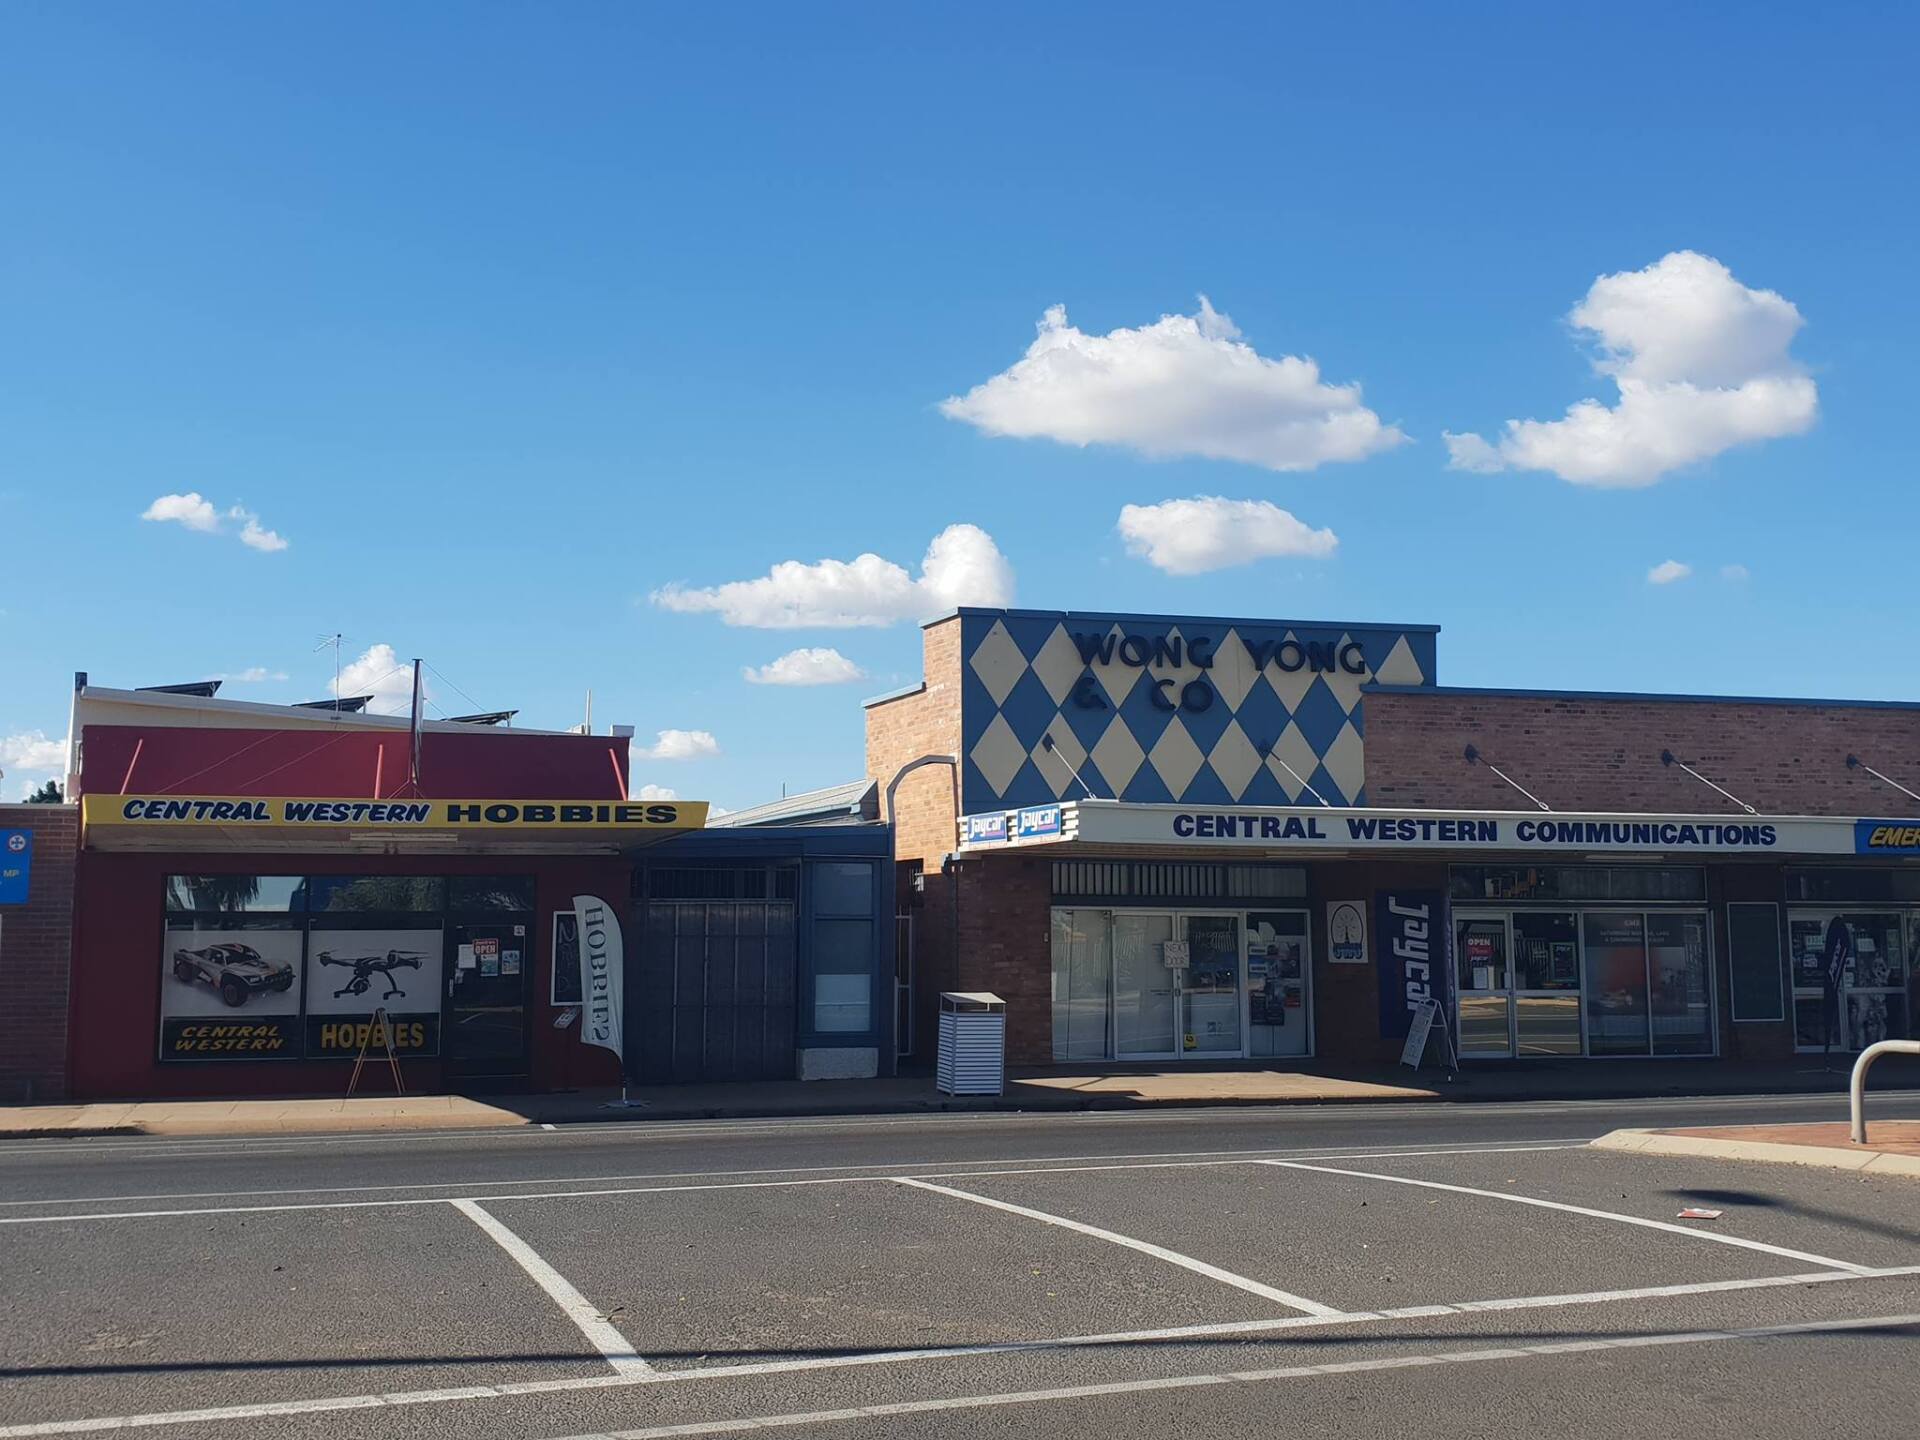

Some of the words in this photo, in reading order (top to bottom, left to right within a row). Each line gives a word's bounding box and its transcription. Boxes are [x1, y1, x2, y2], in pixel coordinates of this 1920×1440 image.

[1075, 632, 1213, 668] WONG
[1243, 639, 1366, 675] YONG
[1073, 677, 1108, 710] &
[1152, 679, 1214, 713] CO
[124, 799, 271, 822] CENTRAL
[285, 801, 431, 823] WESTERN
[447, 804, 677, 824] HOBBIES
[1018, 808, 1059, 834] Jaycar
[969, 816, 1005, 839] Jaycar
[1173, 814, 1327, 840] CENTRAL
[1346, 818, 1498, 842] WESTERN
[1516, 821, 1777, 846] COMMUNICATIONS
[475, 944, 497, 954] OPEN
[181, 1025, 279, 1038] CENTRAL
[321, 1022, 424, 1049] HOBBES
[175, 1038, 283, 1051] WESTERN
